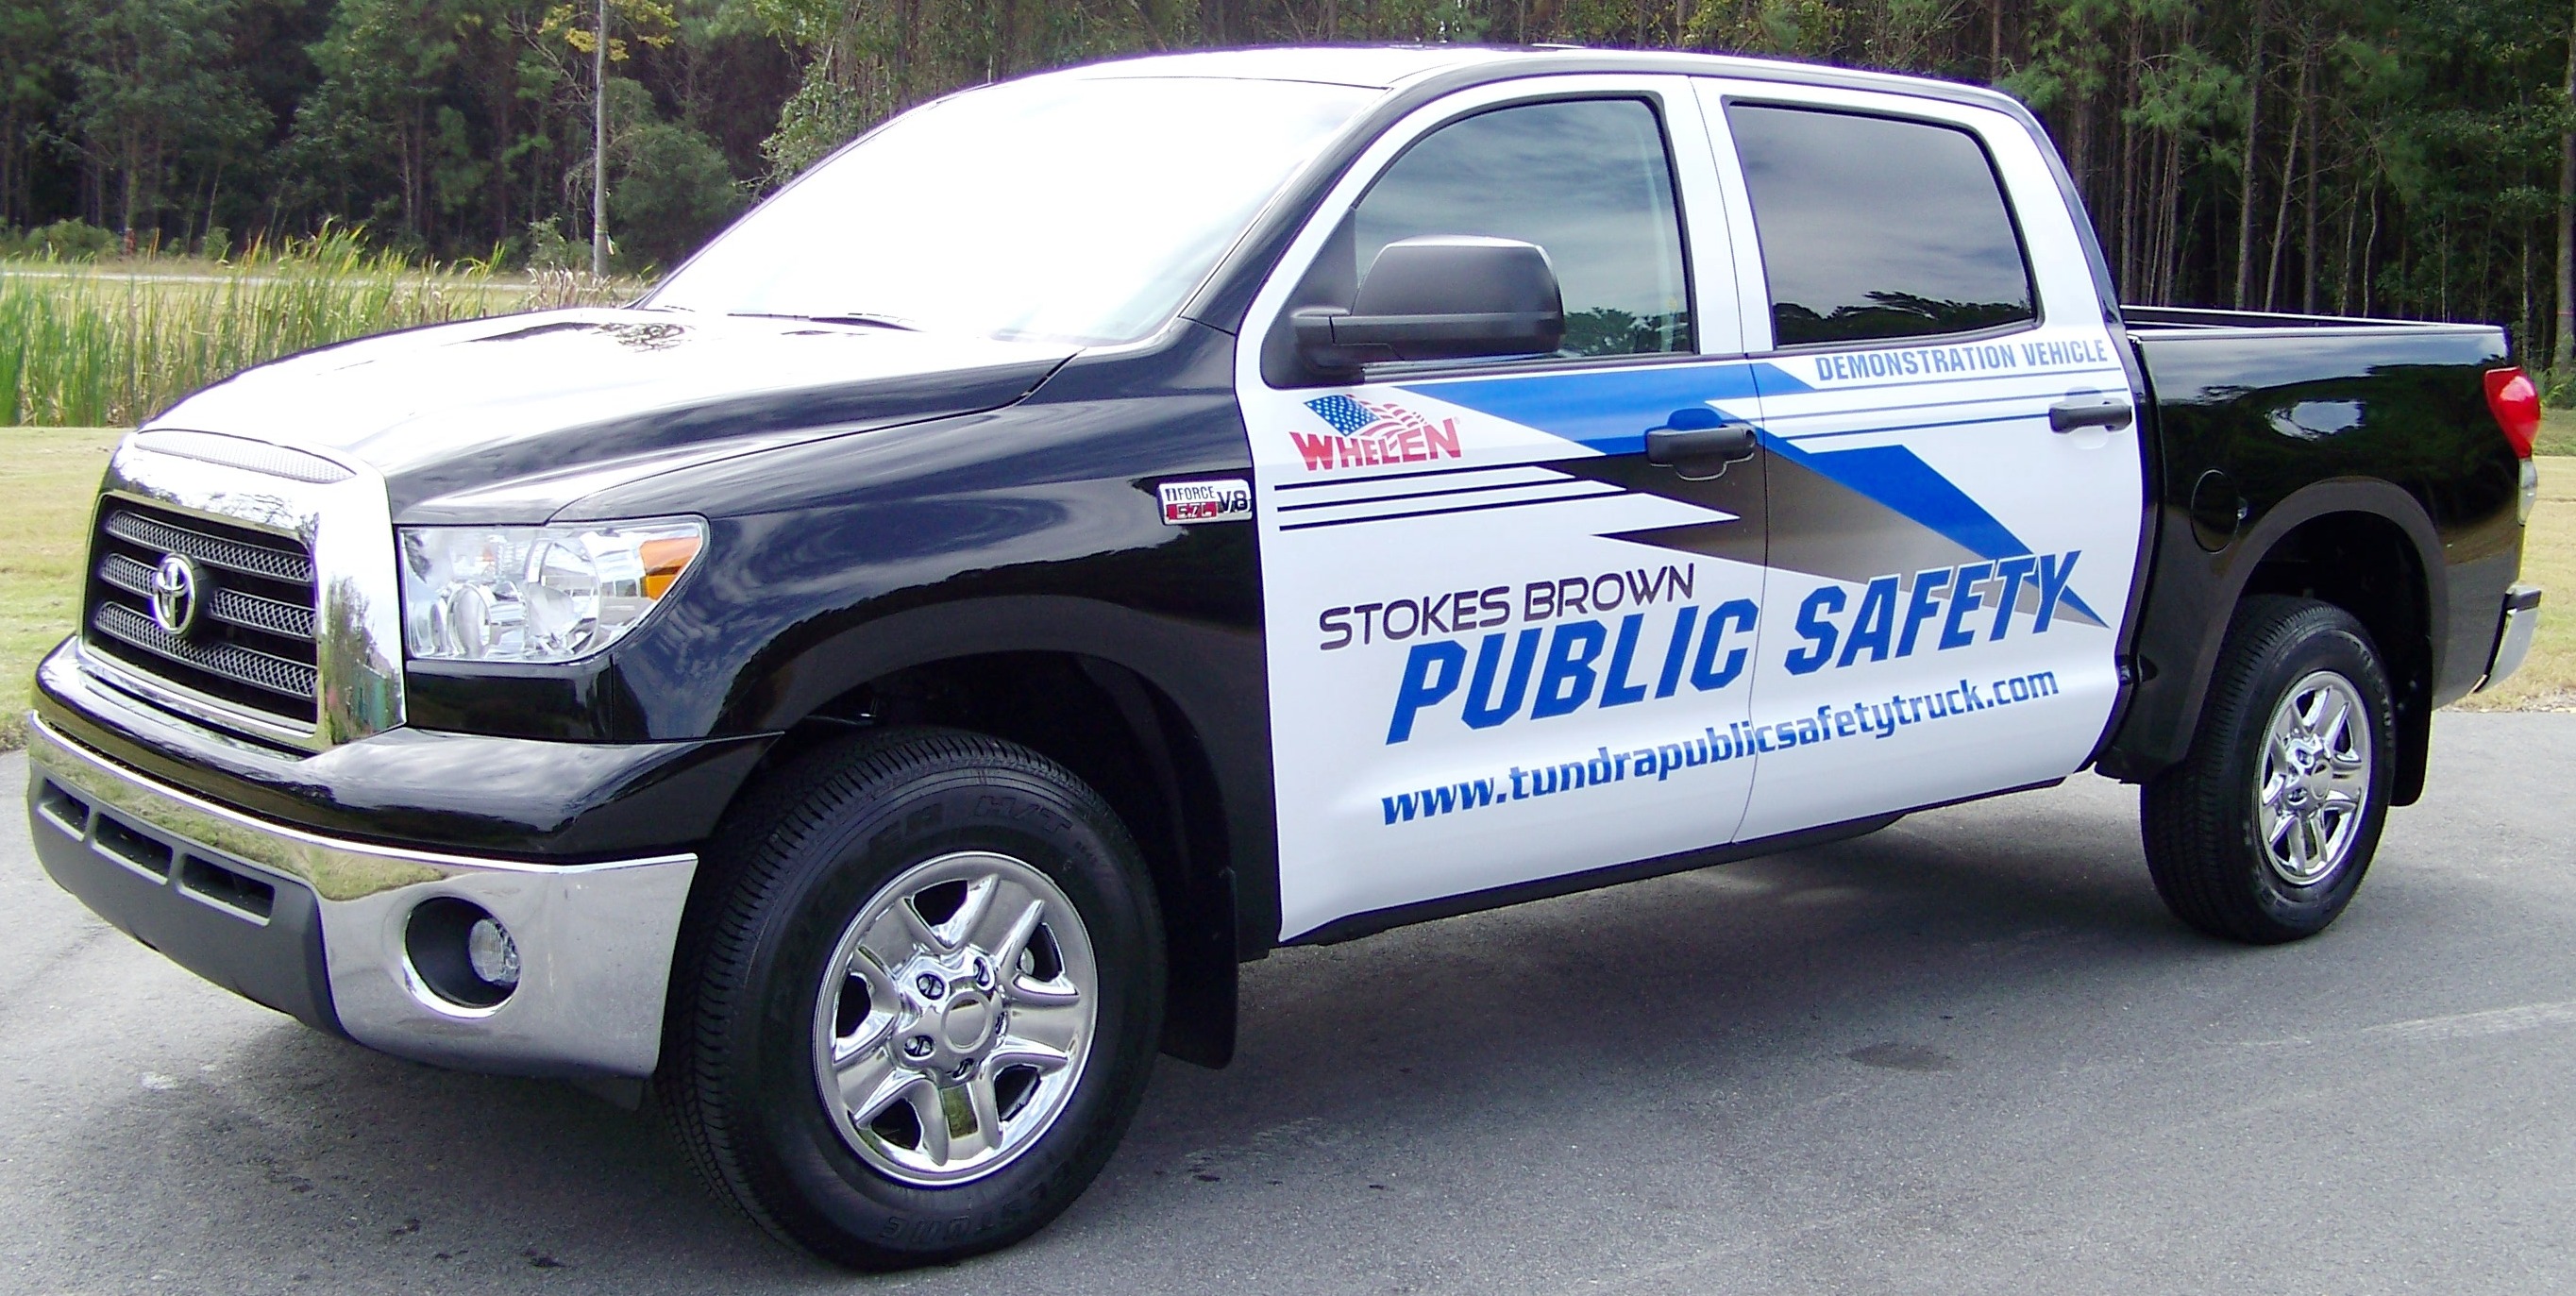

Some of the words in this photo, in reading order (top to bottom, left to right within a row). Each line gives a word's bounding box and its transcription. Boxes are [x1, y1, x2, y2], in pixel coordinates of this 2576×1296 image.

[1815, 344, 2016, 381] DEMONSTRATION
[2020, 339, 2108, 366] VEHICLE
[1288, 416, 1462, 471] WHELEN
[1217, 489, 1250, 513] V8
[1320, 585, 1511, 651] STOKES
[1523, 563, 1695, 622] BROWN
[1386, 598, 1759, 746] PUBLIC
[1784, 549, 2082, 677] SAFETY
[1380, 669, 2060, 826] www.tundrapublicsafetytruck.com
